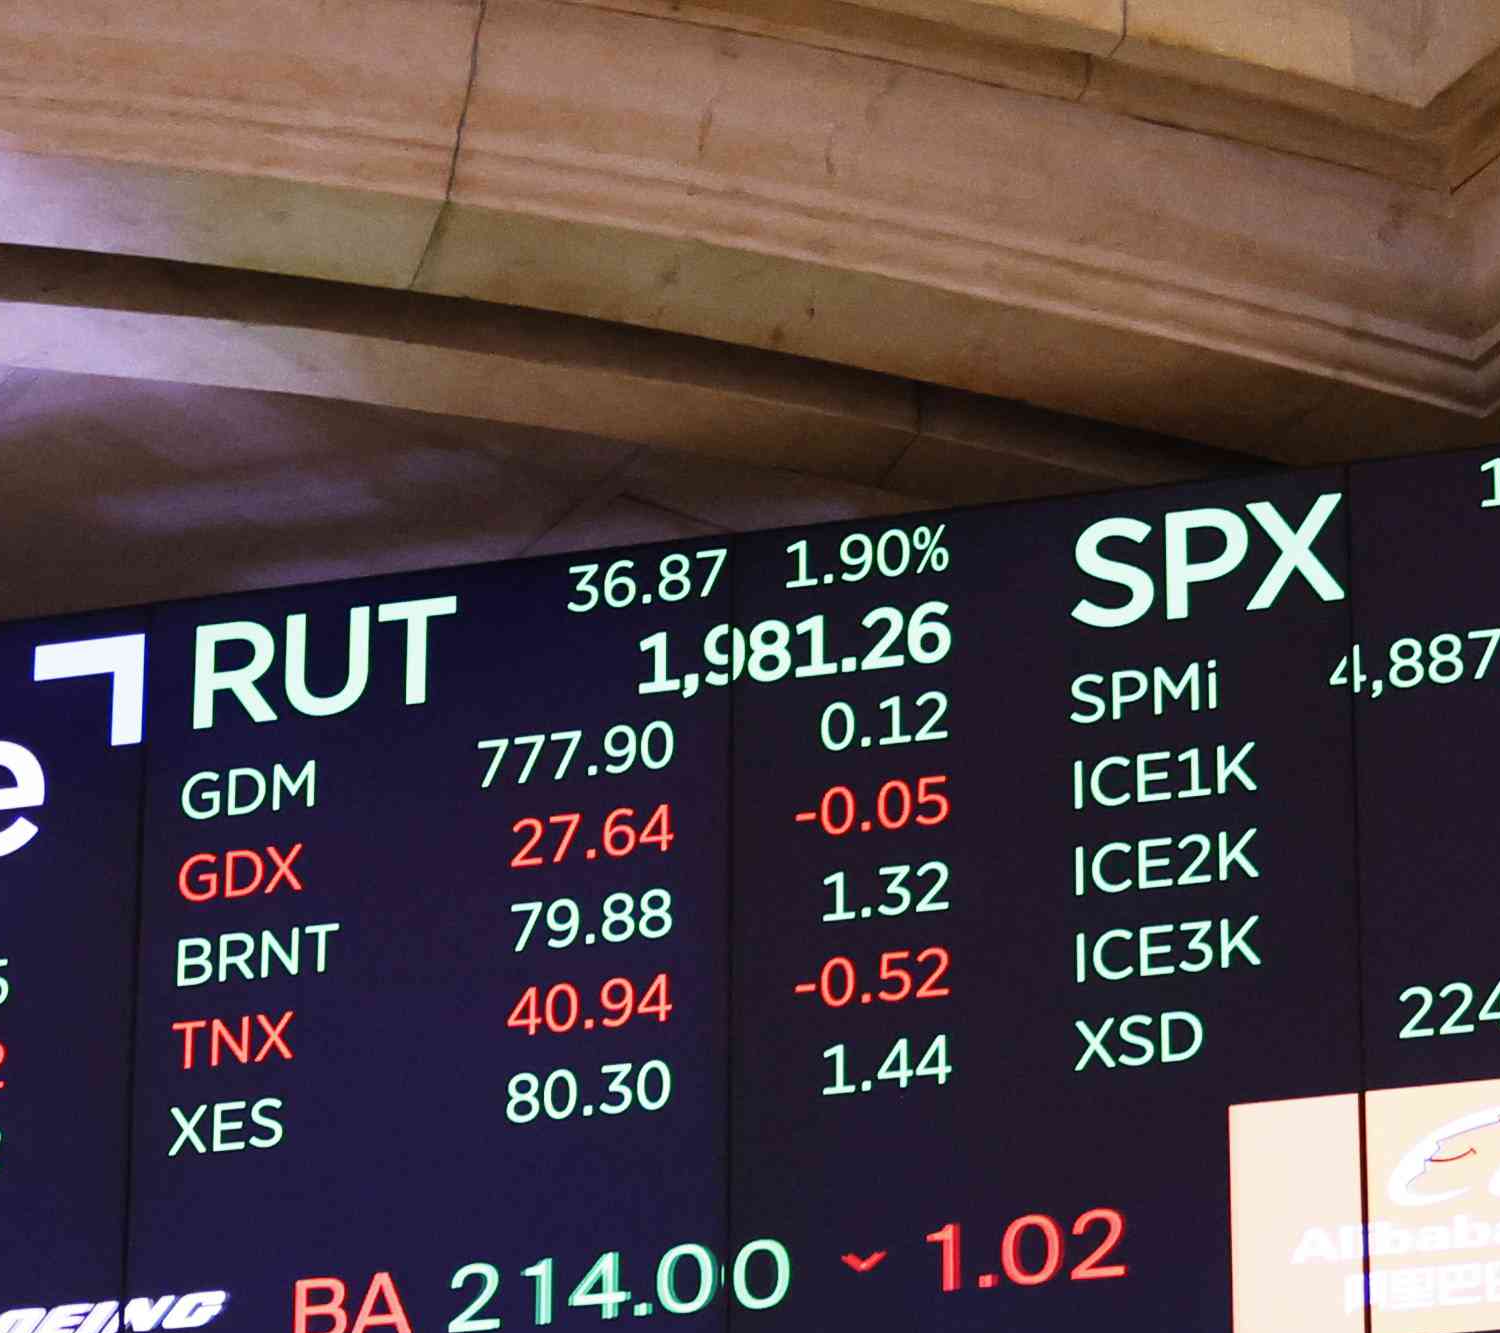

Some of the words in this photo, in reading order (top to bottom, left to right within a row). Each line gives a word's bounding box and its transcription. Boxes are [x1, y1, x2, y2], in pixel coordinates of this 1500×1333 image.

[568, 549, 727, 612] 36.87
[786, 524, 949, 588] 1.90%
[1071, 493, 1344, 627] SPX
[193, 596, 456, 729] RUT
[639, 594, 951, 698] 1,981.26
[1070, 660, 1217, 723] SPMi
[182, 760, 315, 819] GDM
[478, 721, 674, 787] 777.90
[821, 691, 948, 751] 0.12
[1074, 742, 1257, 809] ICE1K
[178, 843, 302, 903] GDX
[510, 804, 674, 868] 27.64
[795, 775, 951, 835] -0.05
[1076, 828, 1259, 895] ICE2K
[177, 923, 339, 986] BRNT
[511, 889, 672, 952] 79.88
[823, 861, 949, 921] 1.32
[1077, 915, 1261, 982] ICE3K
[172, 1011, 293, 1069] TNX
[507, 973, 672, 1035] 40.94
[795, 947, 951, 1008] -0.52
[1075, 1011, 1203, 1071] XSD
[168, 1098, 283, 1156] XES
[506, 1060, 671, 1123] 80.30
[823, 1035, 952, 1095] 1.44
[448, 1239, 790, 1333] 214.00
[926, 1208, 1128, 1292] 1.02
